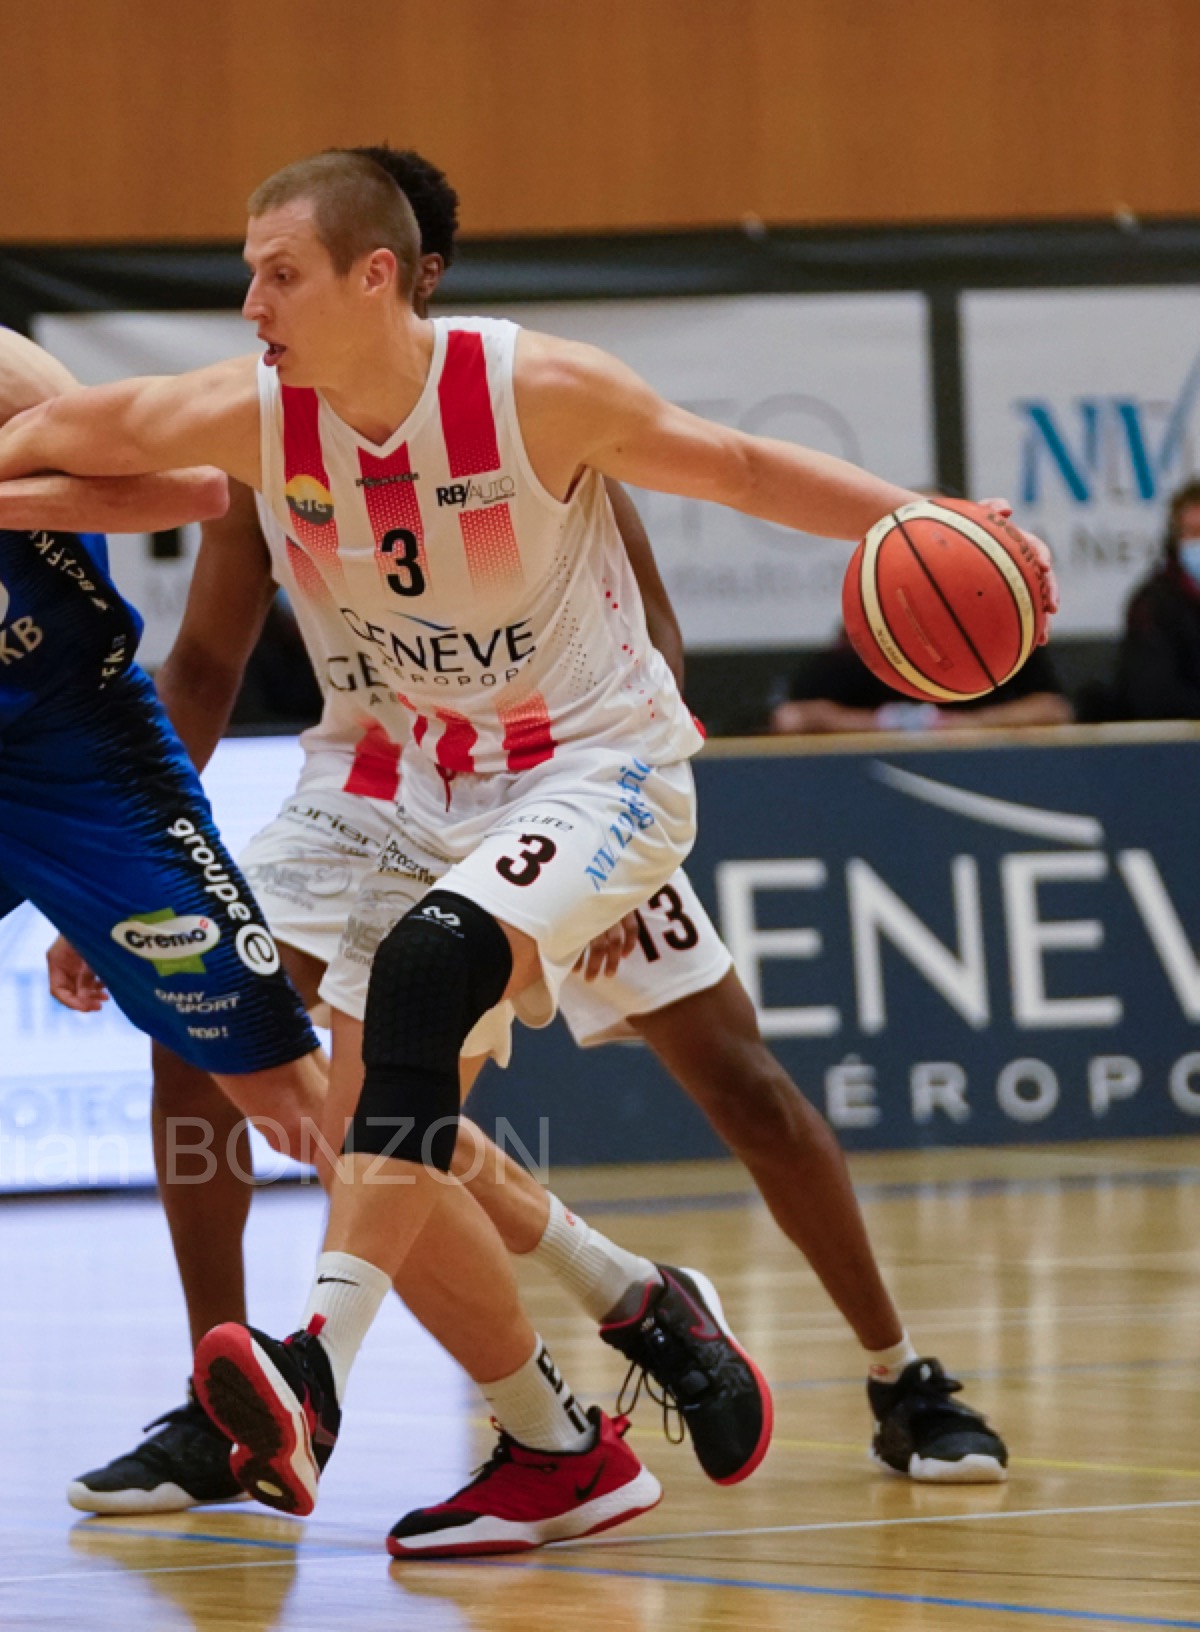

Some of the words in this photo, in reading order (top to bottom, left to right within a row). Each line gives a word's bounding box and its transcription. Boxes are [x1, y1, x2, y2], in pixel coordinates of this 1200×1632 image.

[380, 528, 426, 597] 3
[167, 817, 251, 921] groupe
[495, 833, 557, 887] 3
[715, 760, 1200, 1038] ENÈV
[124, 928, 208, 949] Cremo
[633, 883, 699, 963] 13
[823, 1050, 1200, 1128] ÉROPO
